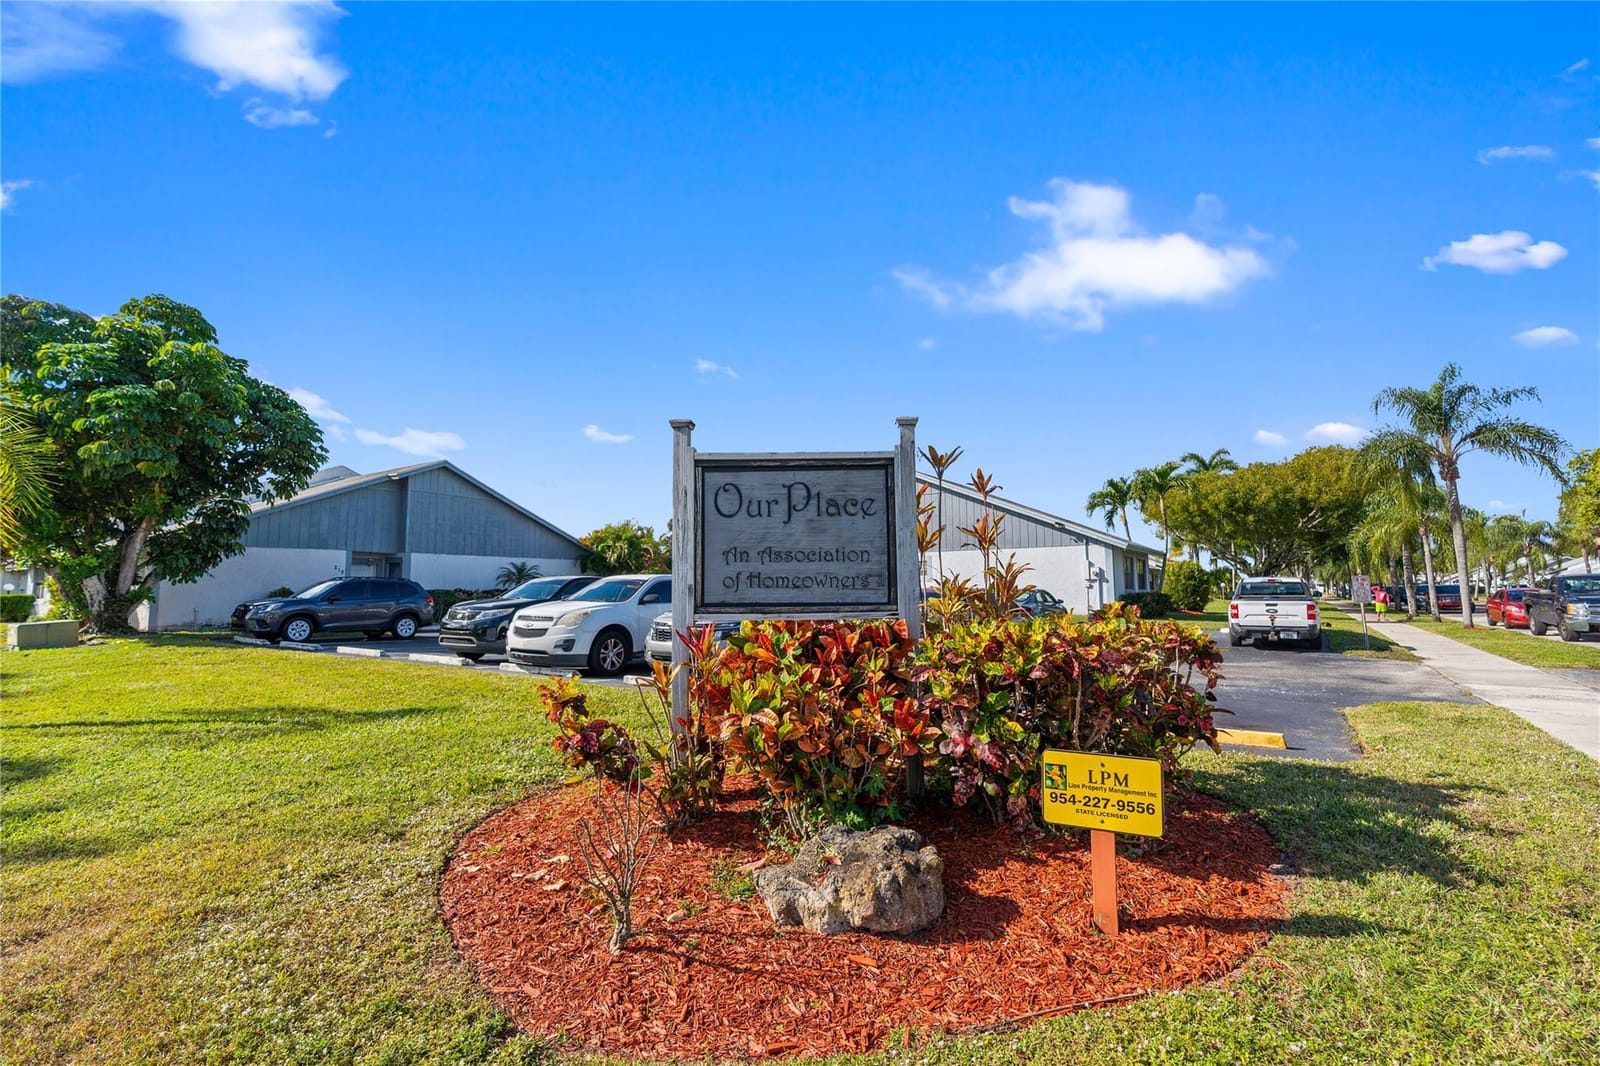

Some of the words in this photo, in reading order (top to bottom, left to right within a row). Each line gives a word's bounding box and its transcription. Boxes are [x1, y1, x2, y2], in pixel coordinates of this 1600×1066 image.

[714, 482, 779, 518] Our
[782, 481, 877, 524] Place
[722, 547, 750, 565] An
[757, 547, 871, 565] Association
[722, 571, 742, 592] of
[747, 571, 870, 589] Homeowners
[1088, 769, 1130, 788] LPM
[1082, 783, 1107, 793] Property
[1108, 786, 1147, 796] Management
[1147, 790, 1158, 798] Inc
[1049, 791, 1156, 816] 954-227-9556
[1075, 808, 1095, 817] STATE
[1096, 810, 1129, 820] LICENSED
